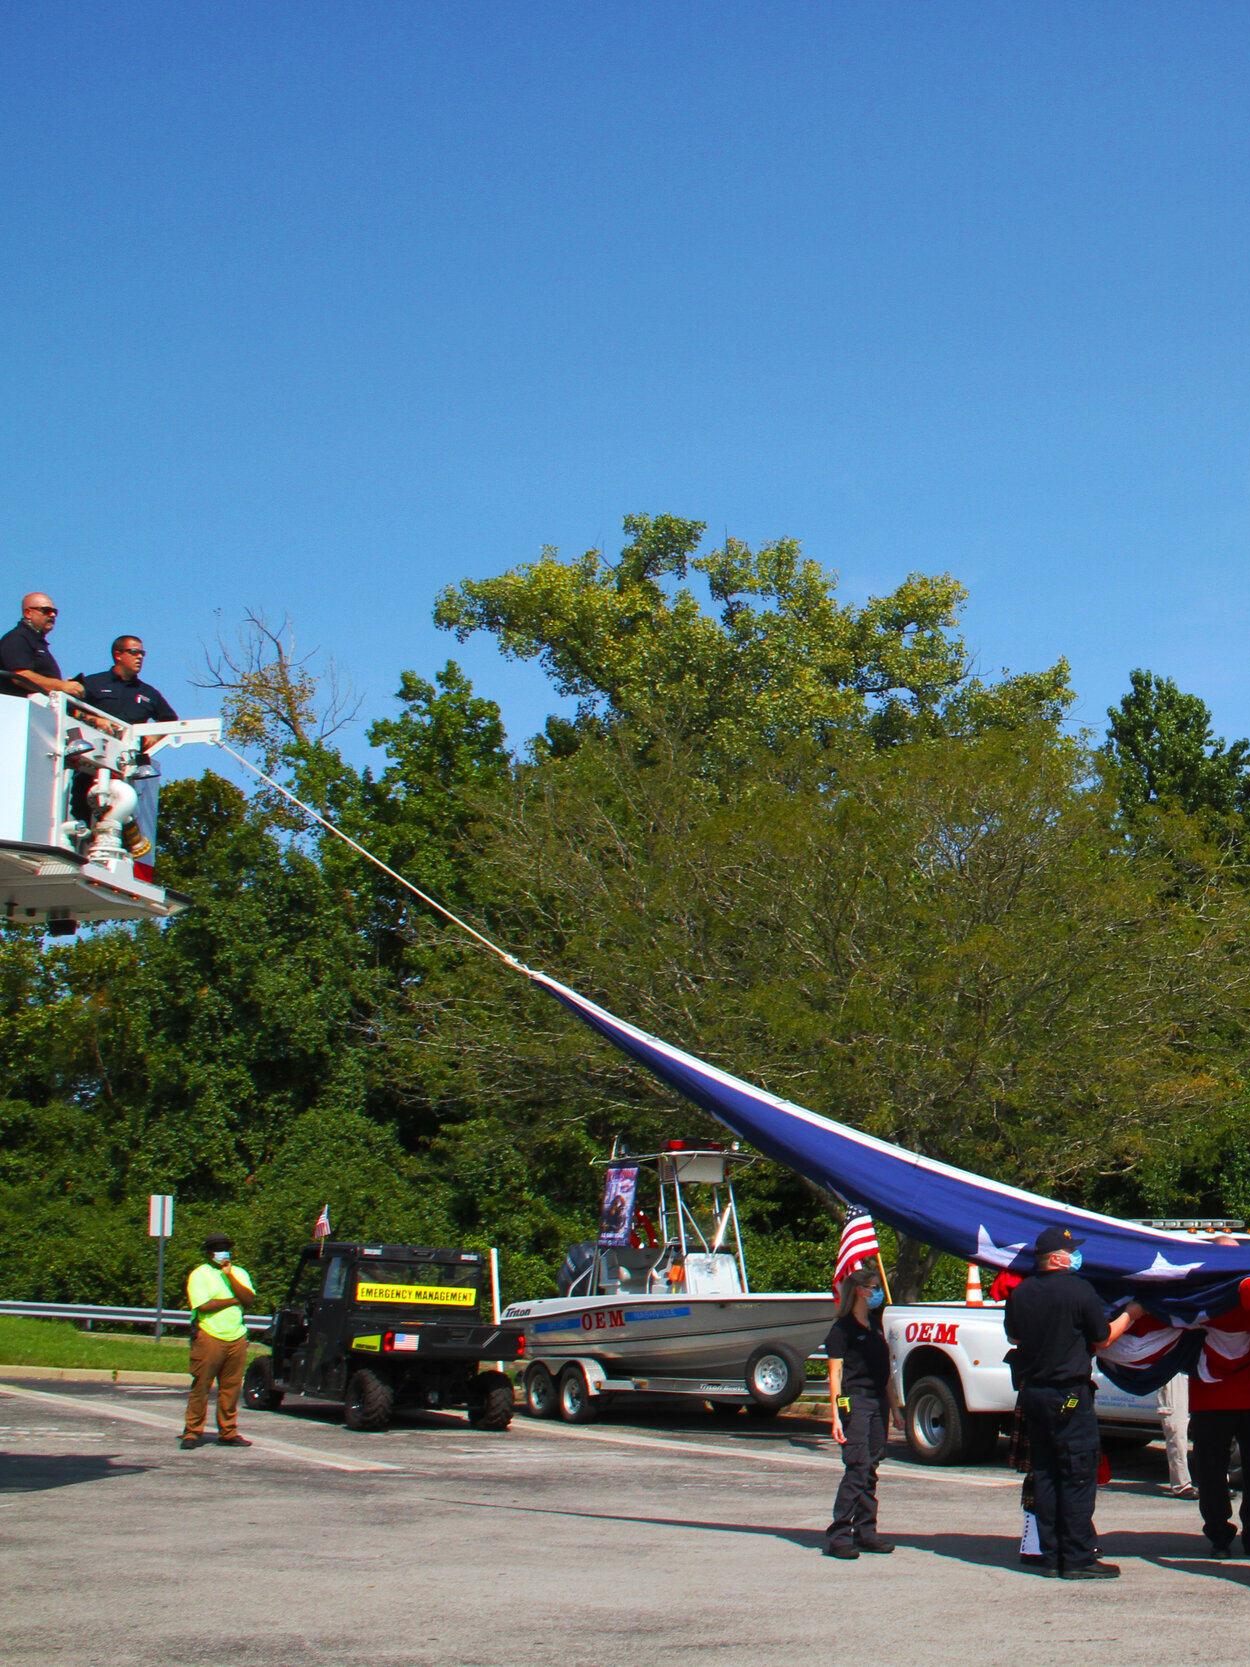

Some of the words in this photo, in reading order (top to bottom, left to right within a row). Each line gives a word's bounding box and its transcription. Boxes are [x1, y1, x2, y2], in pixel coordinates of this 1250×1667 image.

[360, 1287, 412, 1300] EMERGENCY
[414, 1289, 473, 1302] MANAGEMENT
[505, 1307, 531, 1318] Triton
[581, 1309, 626, 1331] OEM
[905, 1322, 960, 1345] OEM
